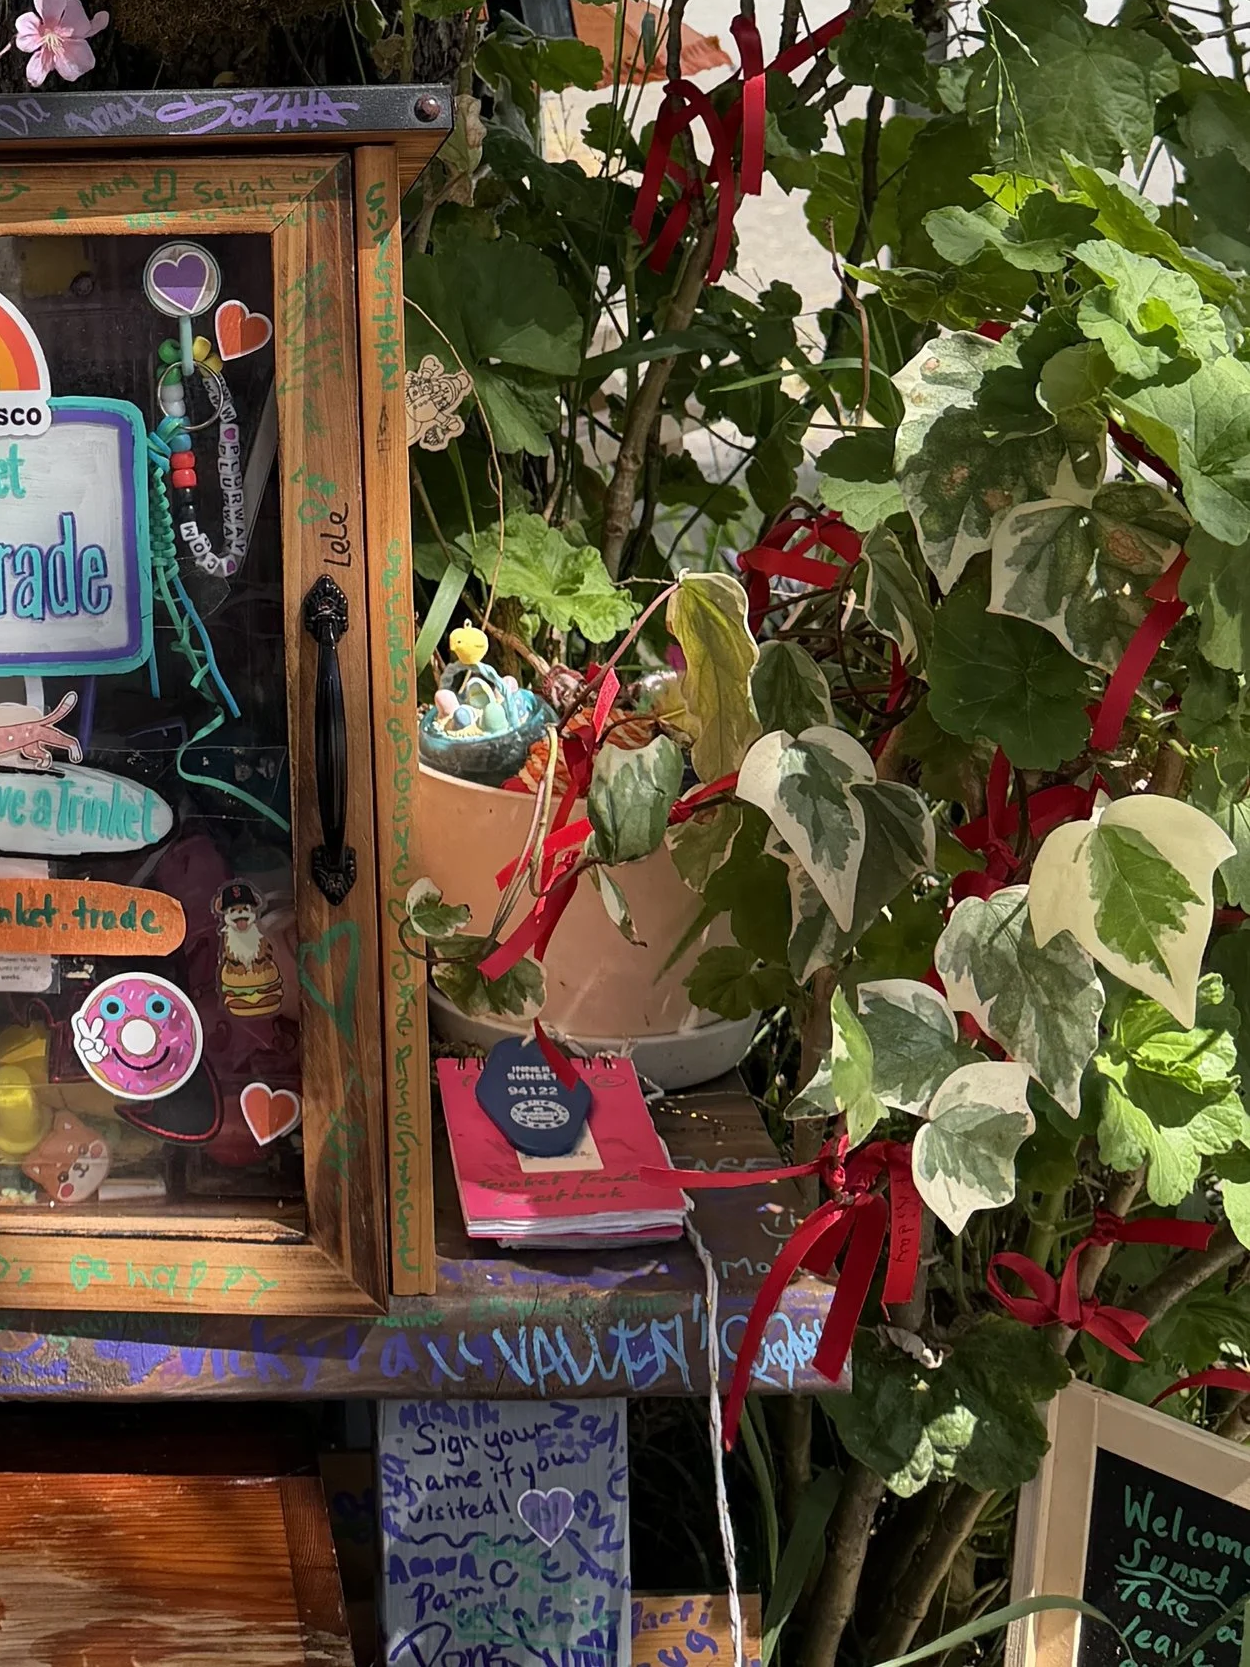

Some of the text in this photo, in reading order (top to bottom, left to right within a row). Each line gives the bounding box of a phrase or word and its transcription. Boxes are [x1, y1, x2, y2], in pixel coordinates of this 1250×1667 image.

[30, 787, 52, 829] a
[53, 778, 159, 843] Trinket
[507, 1086, 559, 1096] 94122
[412, 1420, 552, 1467] Sign your
[403, 1469, 483, 1492] name
[407, 1489, 515, 1524] visited!
[1119, 1537, 1231, 1596] Sunset
[1116, 1578, 1199, 1628] Take
[1121, 1614, 1214, 1667] leae
